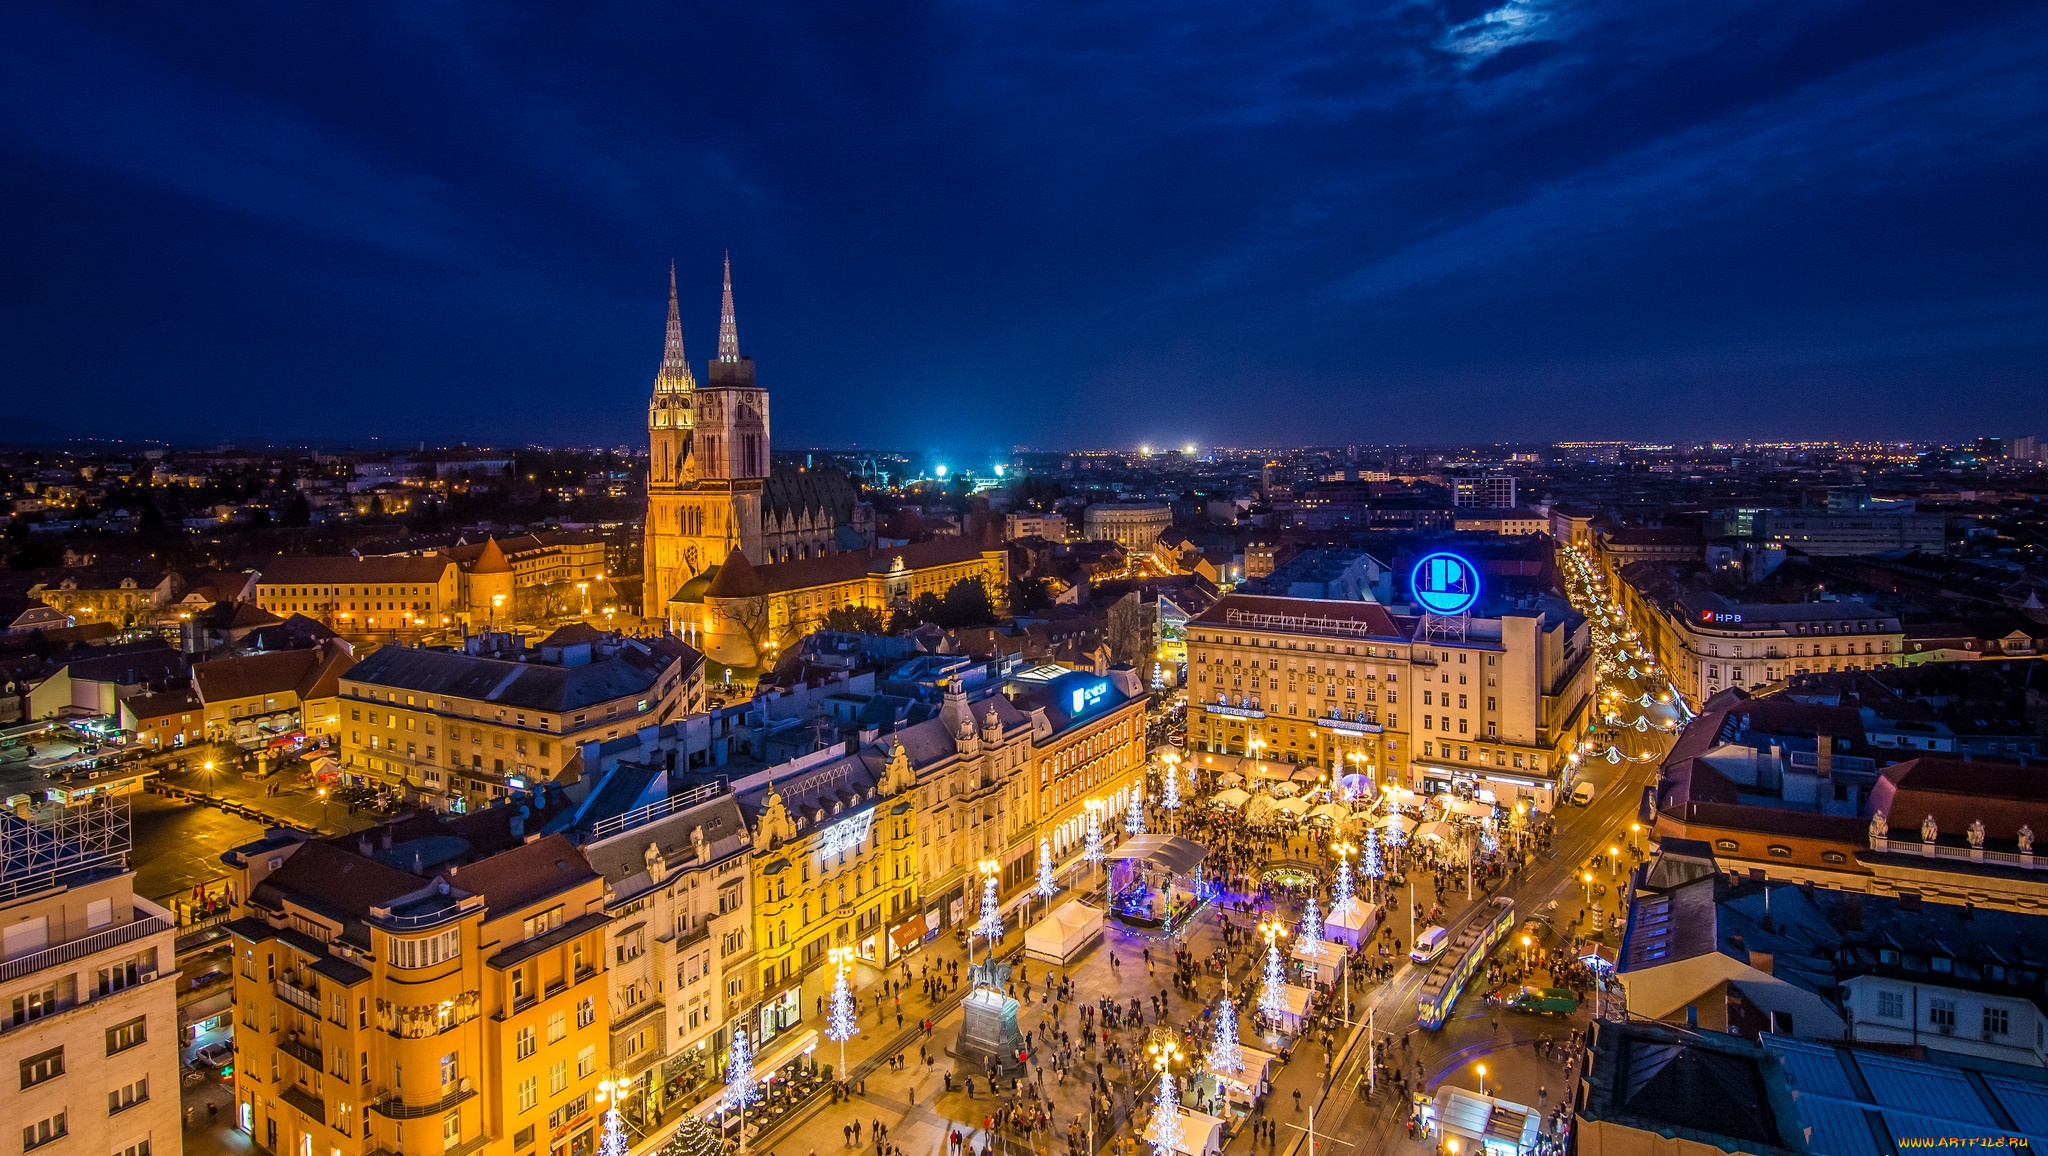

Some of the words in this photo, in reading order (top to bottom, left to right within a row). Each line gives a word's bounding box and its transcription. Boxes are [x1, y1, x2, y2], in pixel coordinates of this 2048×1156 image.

[1715, 613, 1742, 622] HPB
[1206, 664, 1268, 678] GRADSKA
[821, 807, 876, 861] 2017
